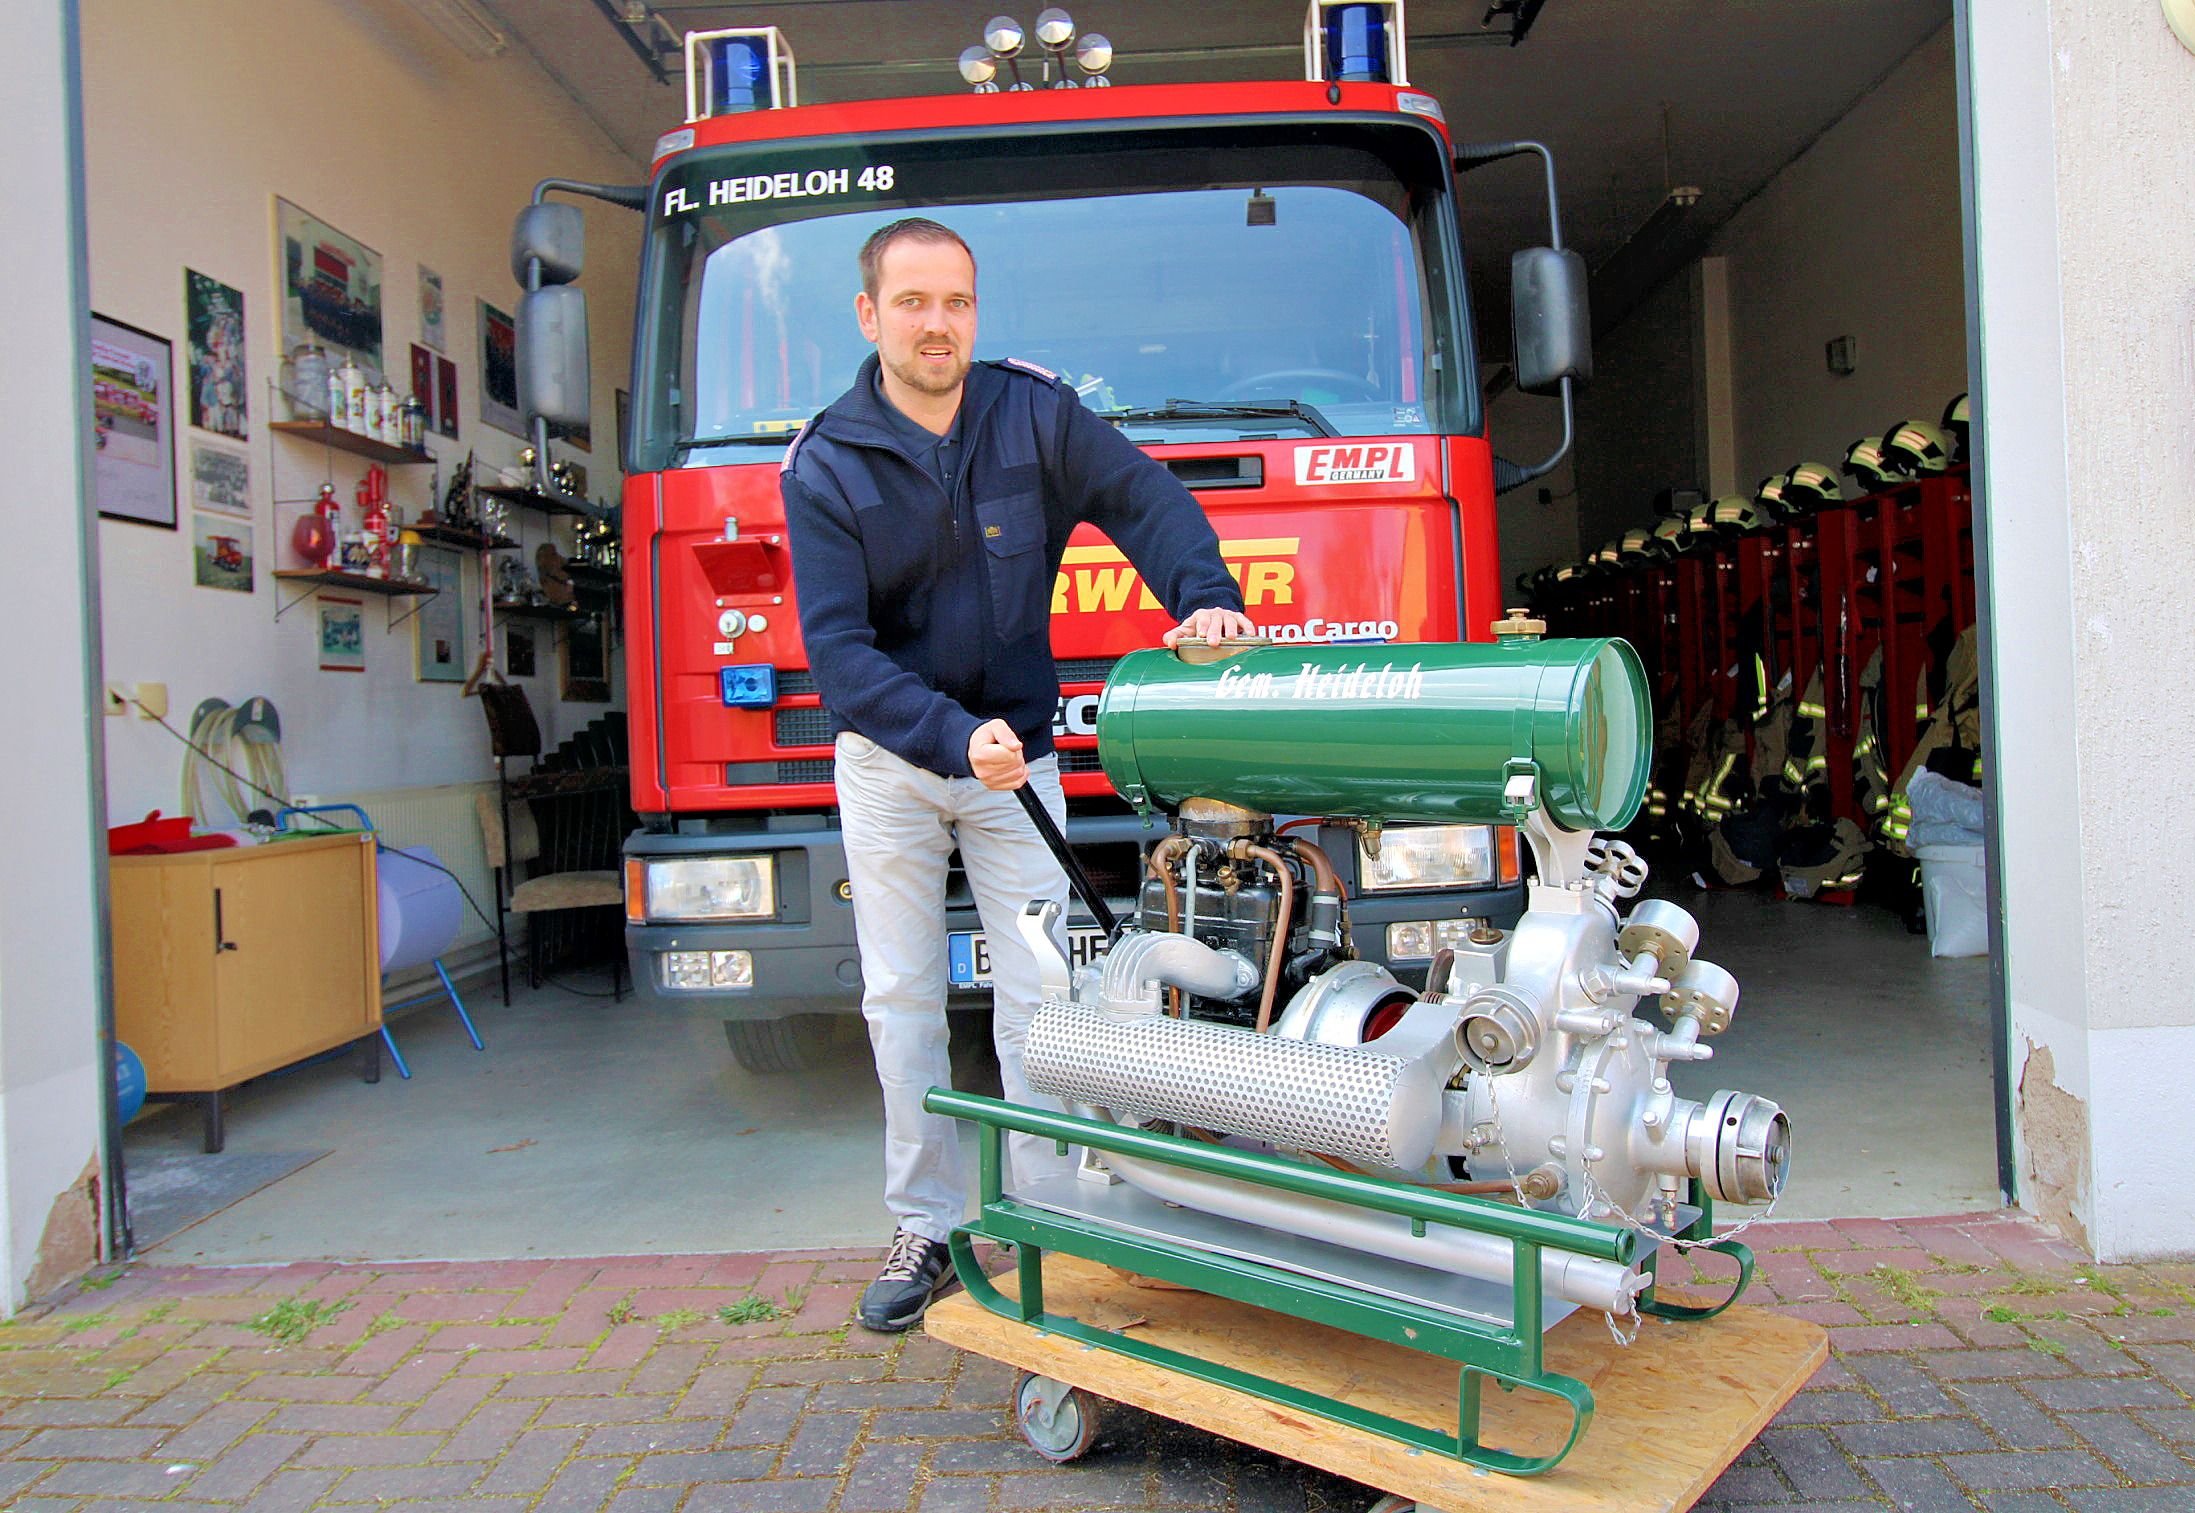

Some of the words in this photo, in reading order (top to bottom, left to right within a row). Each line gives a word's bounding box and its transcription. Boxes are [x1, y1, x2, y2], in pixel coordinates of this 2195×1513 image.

[664, 187, 700, 216] FL.
[709, 168, 849, 206] HEIDELOH
[857, 165, 895, 191] 48
[1306, 446, 1404, 481] EMPL
[1330, 469, 1383, 481] GERMANY
[1291, 661, 1425, 700] Heideloh
[957, 962, 967, 974] D
